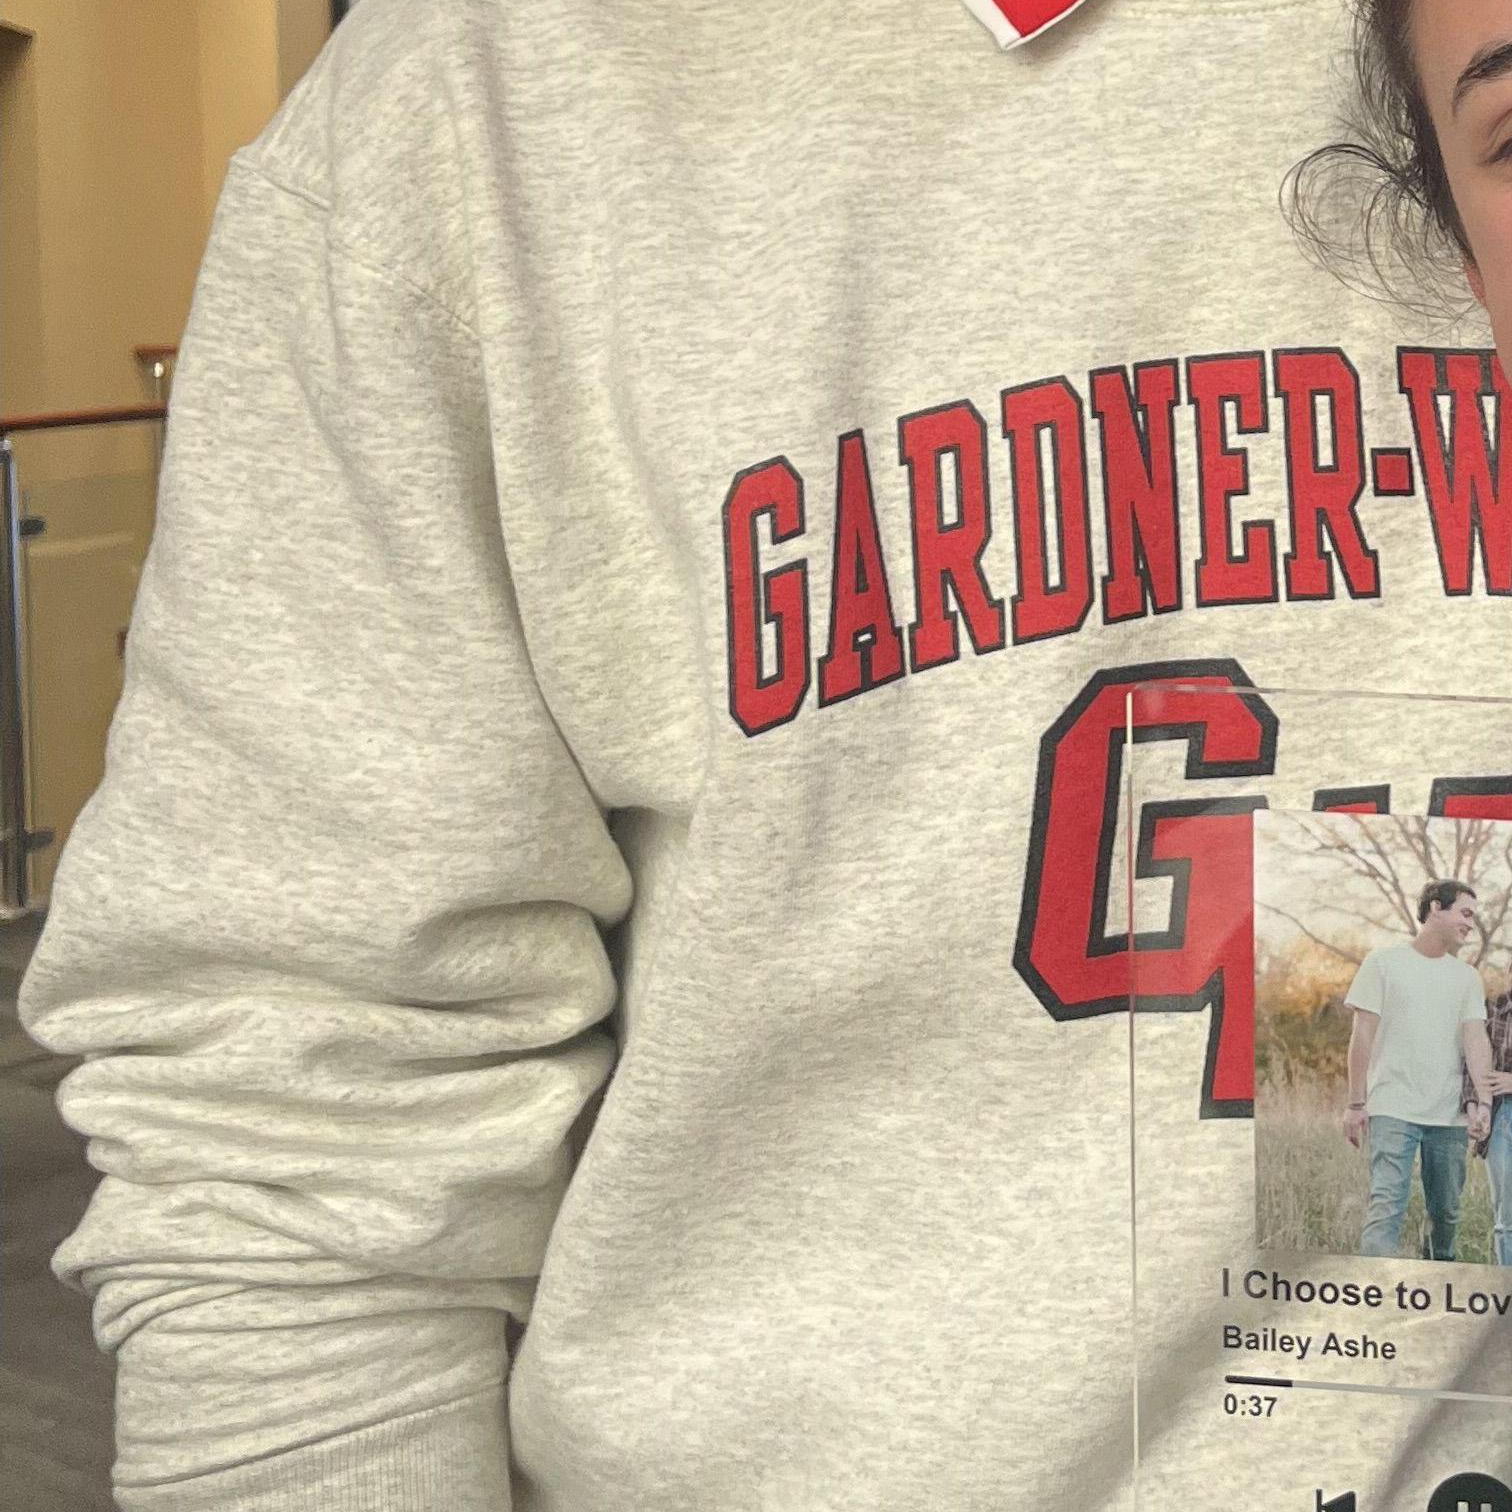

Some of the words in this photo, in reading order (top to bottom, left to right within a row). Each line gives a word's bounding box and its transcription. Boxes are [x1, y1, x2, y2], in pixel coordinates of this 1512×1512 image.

[1222, 1267, 1230, 1297] I
[1243, 1269, 1384, 1308] Choose
[1395, 1280, 1432, 1310] to
[1222, 1324, 1312, 1360] Bailey
[1321, 1332, 1397, 1360] Ashe
[1223, 1393, 1278, 1418] 0:37
